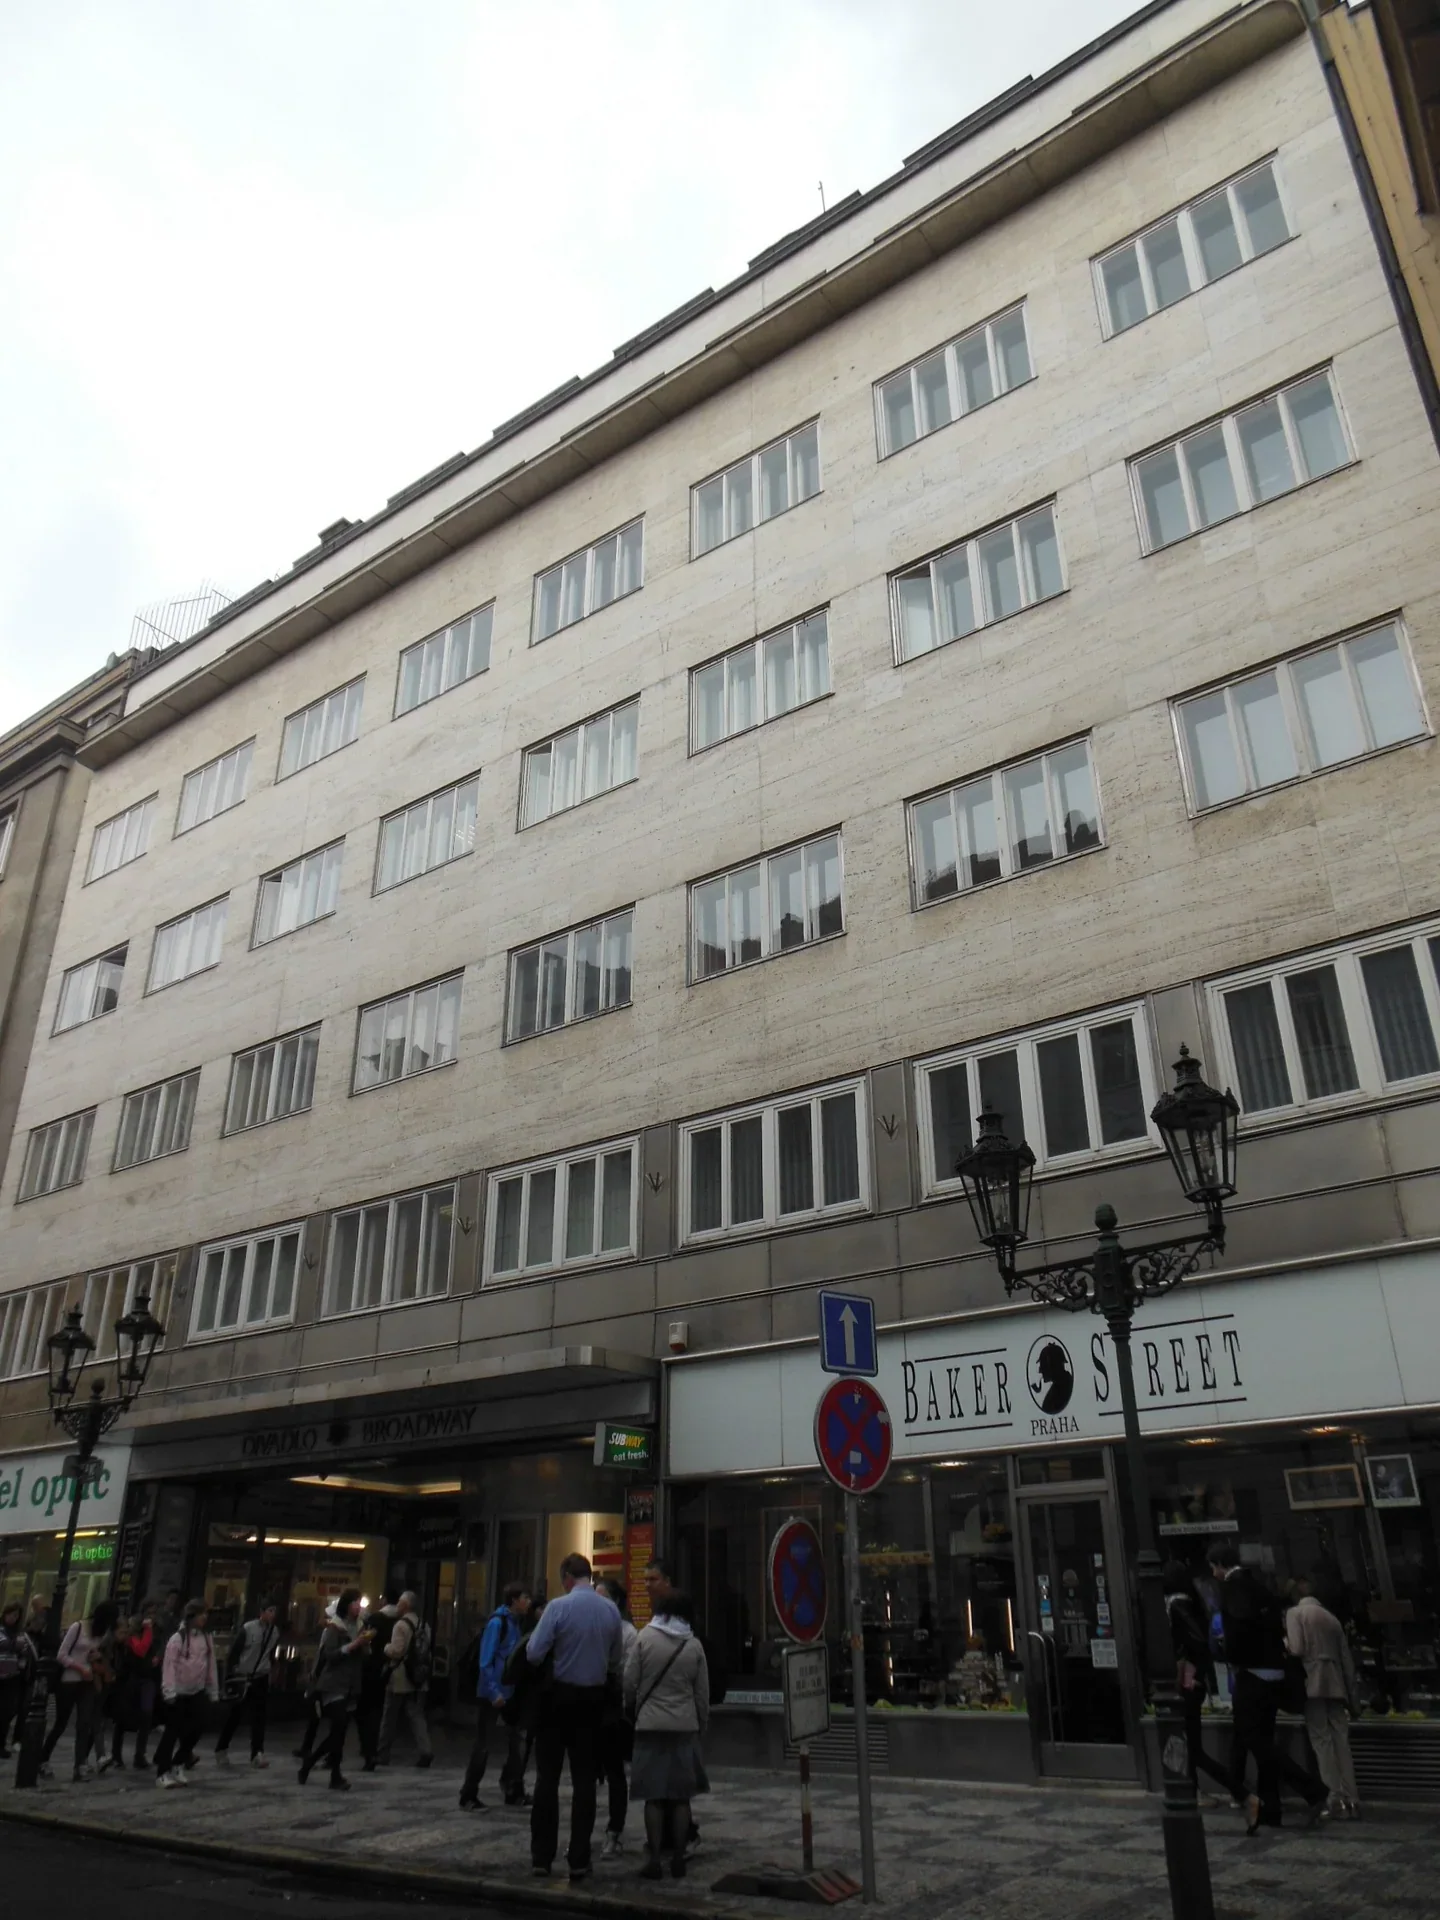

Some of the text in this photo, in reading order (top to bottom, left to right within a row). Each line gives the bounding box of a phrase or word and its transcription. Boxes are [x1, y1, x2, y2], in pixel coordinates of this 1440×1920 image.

[901, 1330, 1242, 1424] BAKER SREET
[242, 1406, 477, 1455] DIVADLO BROADWAY
[1030, 1415, 1080, 1436] PRAHA
[608, 1432, 645, 1449] SUBWAY
[613, 1452, 626, 1462] eat
